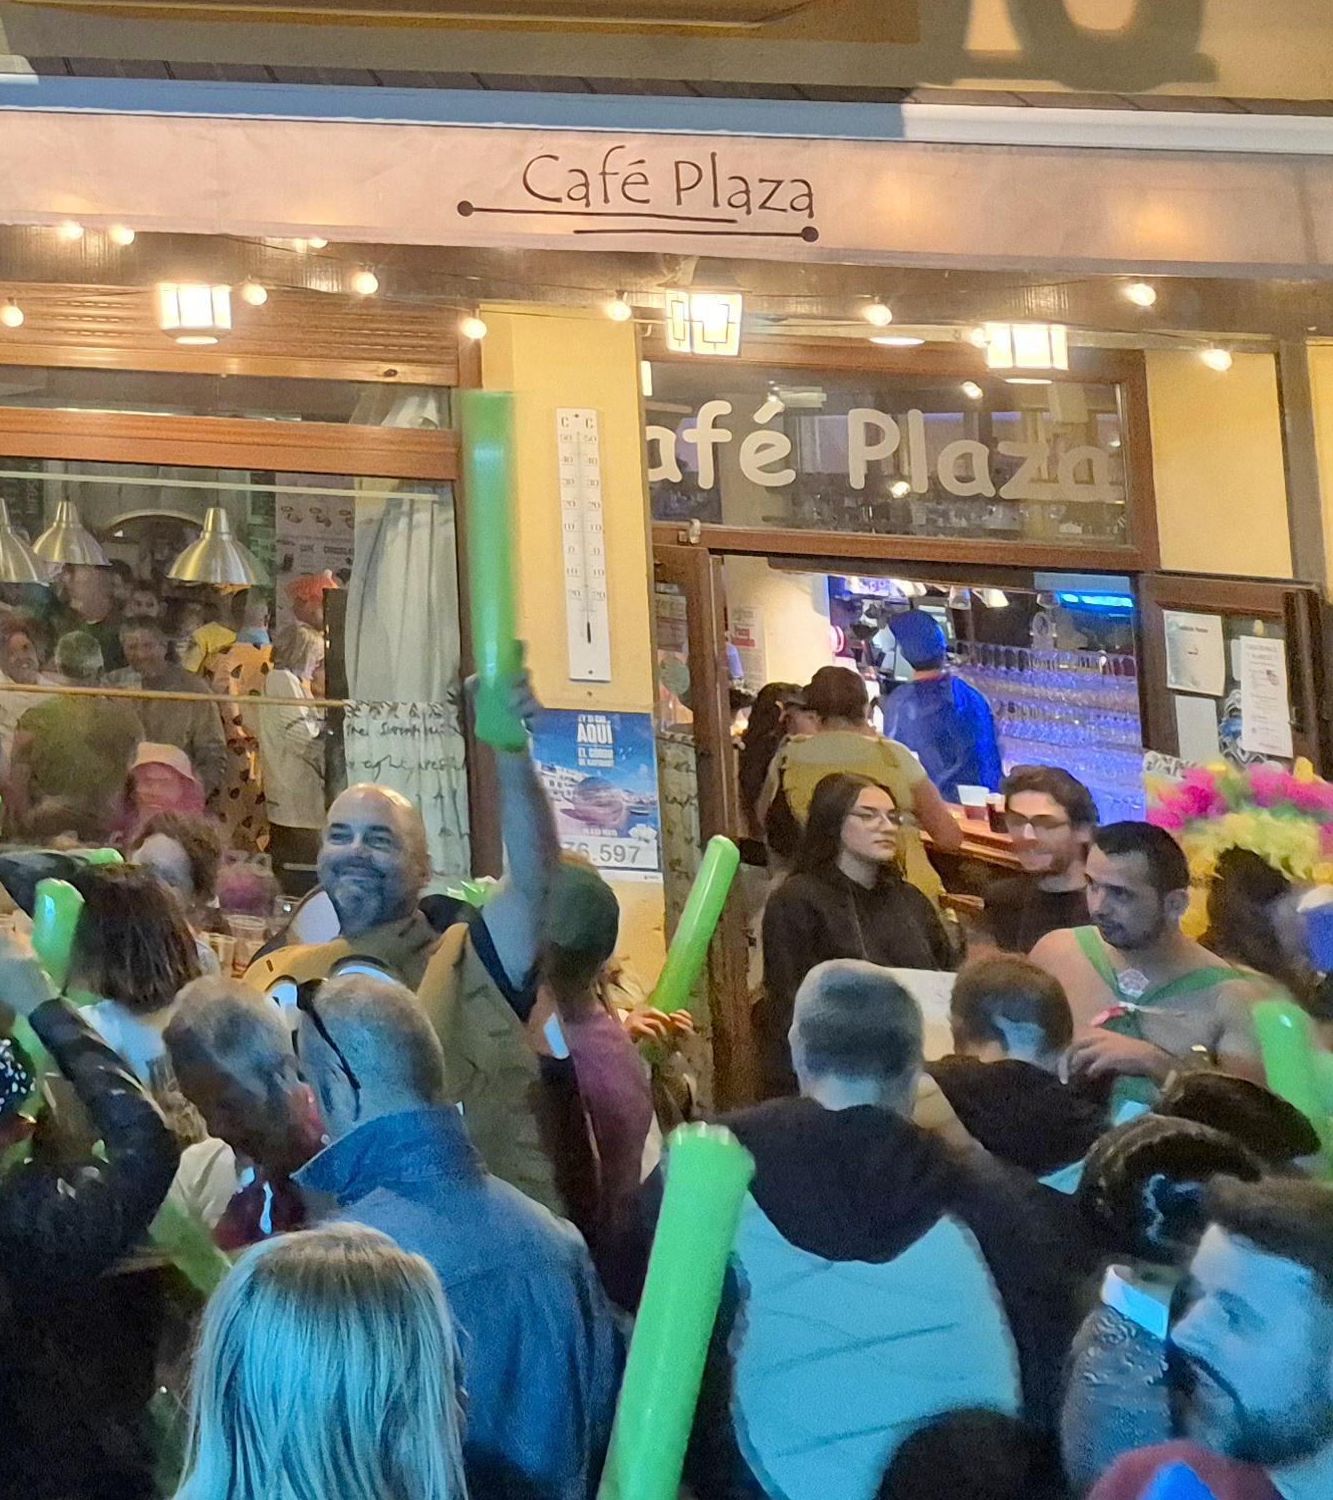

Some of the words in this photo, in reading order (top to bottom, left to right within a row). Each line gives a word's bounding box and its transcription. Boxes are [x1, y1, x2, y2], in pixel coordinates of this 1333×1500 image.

[523, 145, 651, 208] Café
[674, 151, 815, 219] Plaza
[645, 400, 796, 490] afé
[848, 408, 1113, 500] Plaza
[577, 720, 613, 744] AQUÍ
